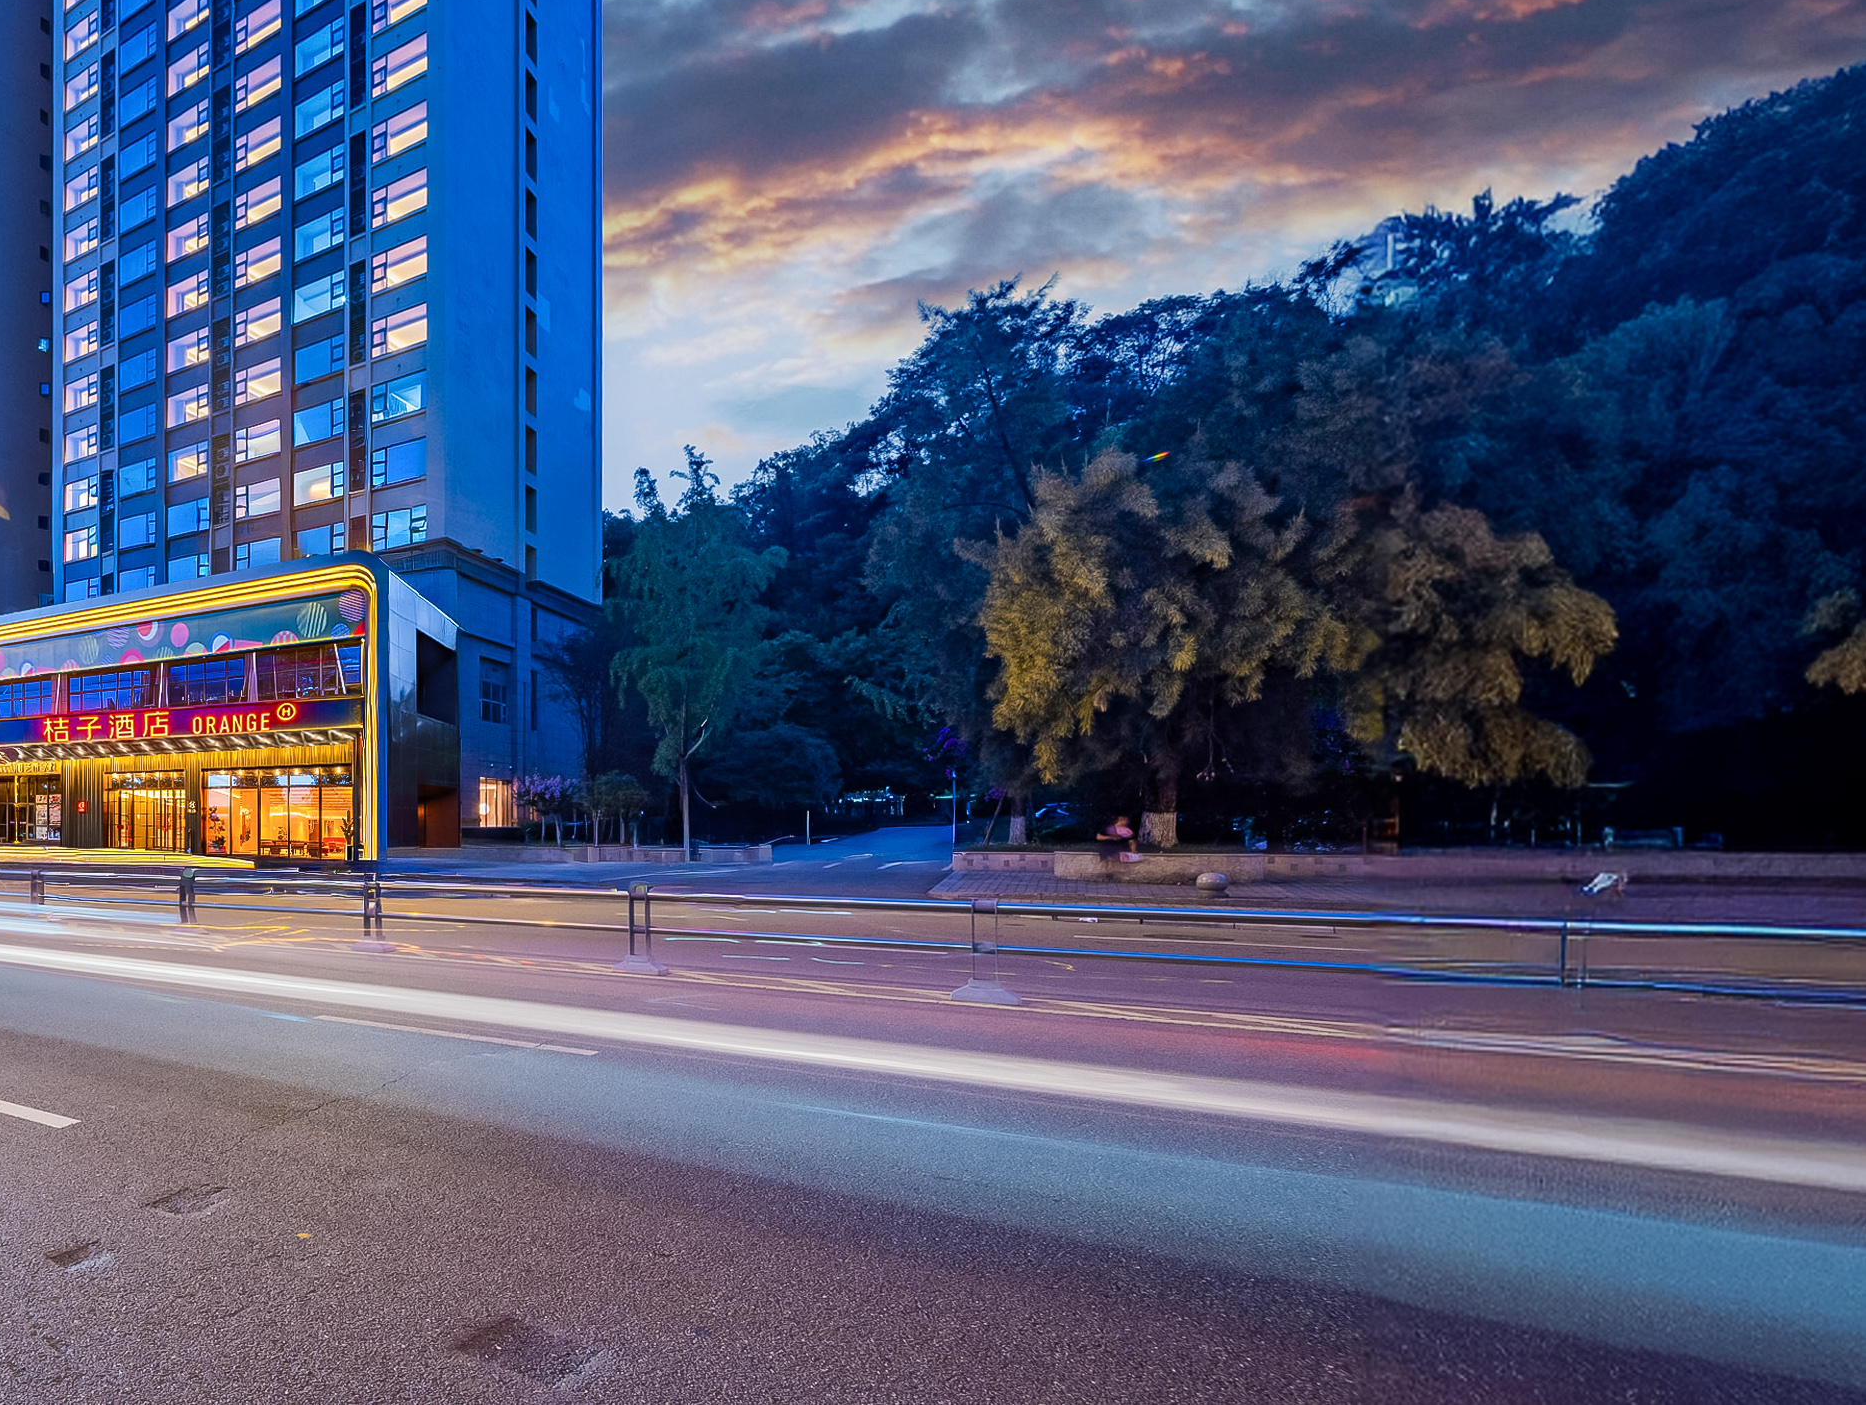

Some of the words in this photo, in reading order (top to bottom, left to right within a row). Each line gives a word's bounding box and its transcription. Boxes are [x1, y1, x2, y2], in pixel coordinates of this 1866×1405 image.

[43, 711, 170, 743] 桔子酒店
[192, 713, 271, 735] ORANGE
